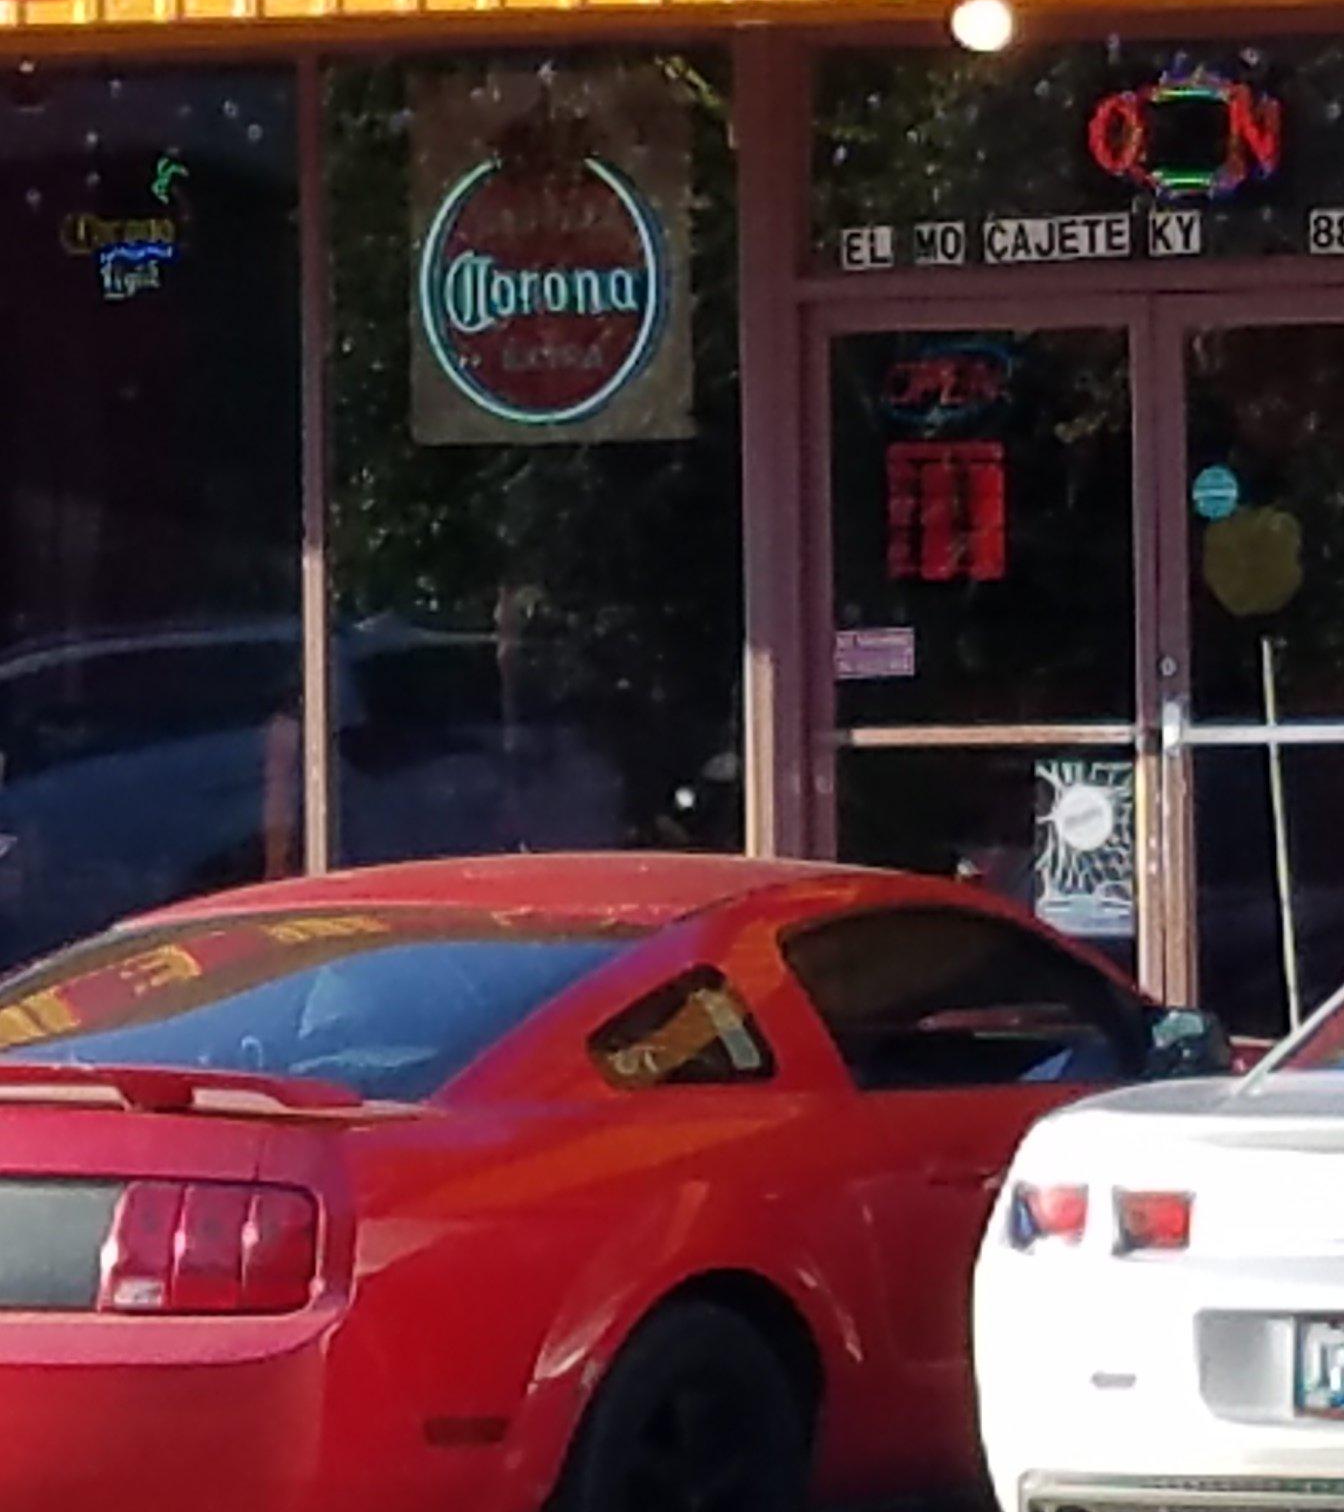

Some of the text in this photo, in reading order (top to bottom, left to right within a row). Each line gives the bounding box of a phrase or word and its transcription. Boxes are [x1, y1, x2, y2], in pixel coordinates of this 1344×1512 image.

[846, 231, 889, 265] EL
[986, 217, 1126, 259] CAJETE
[1151, 215, 1197, 252] KY
[444, 249, 640, 334] Corona
